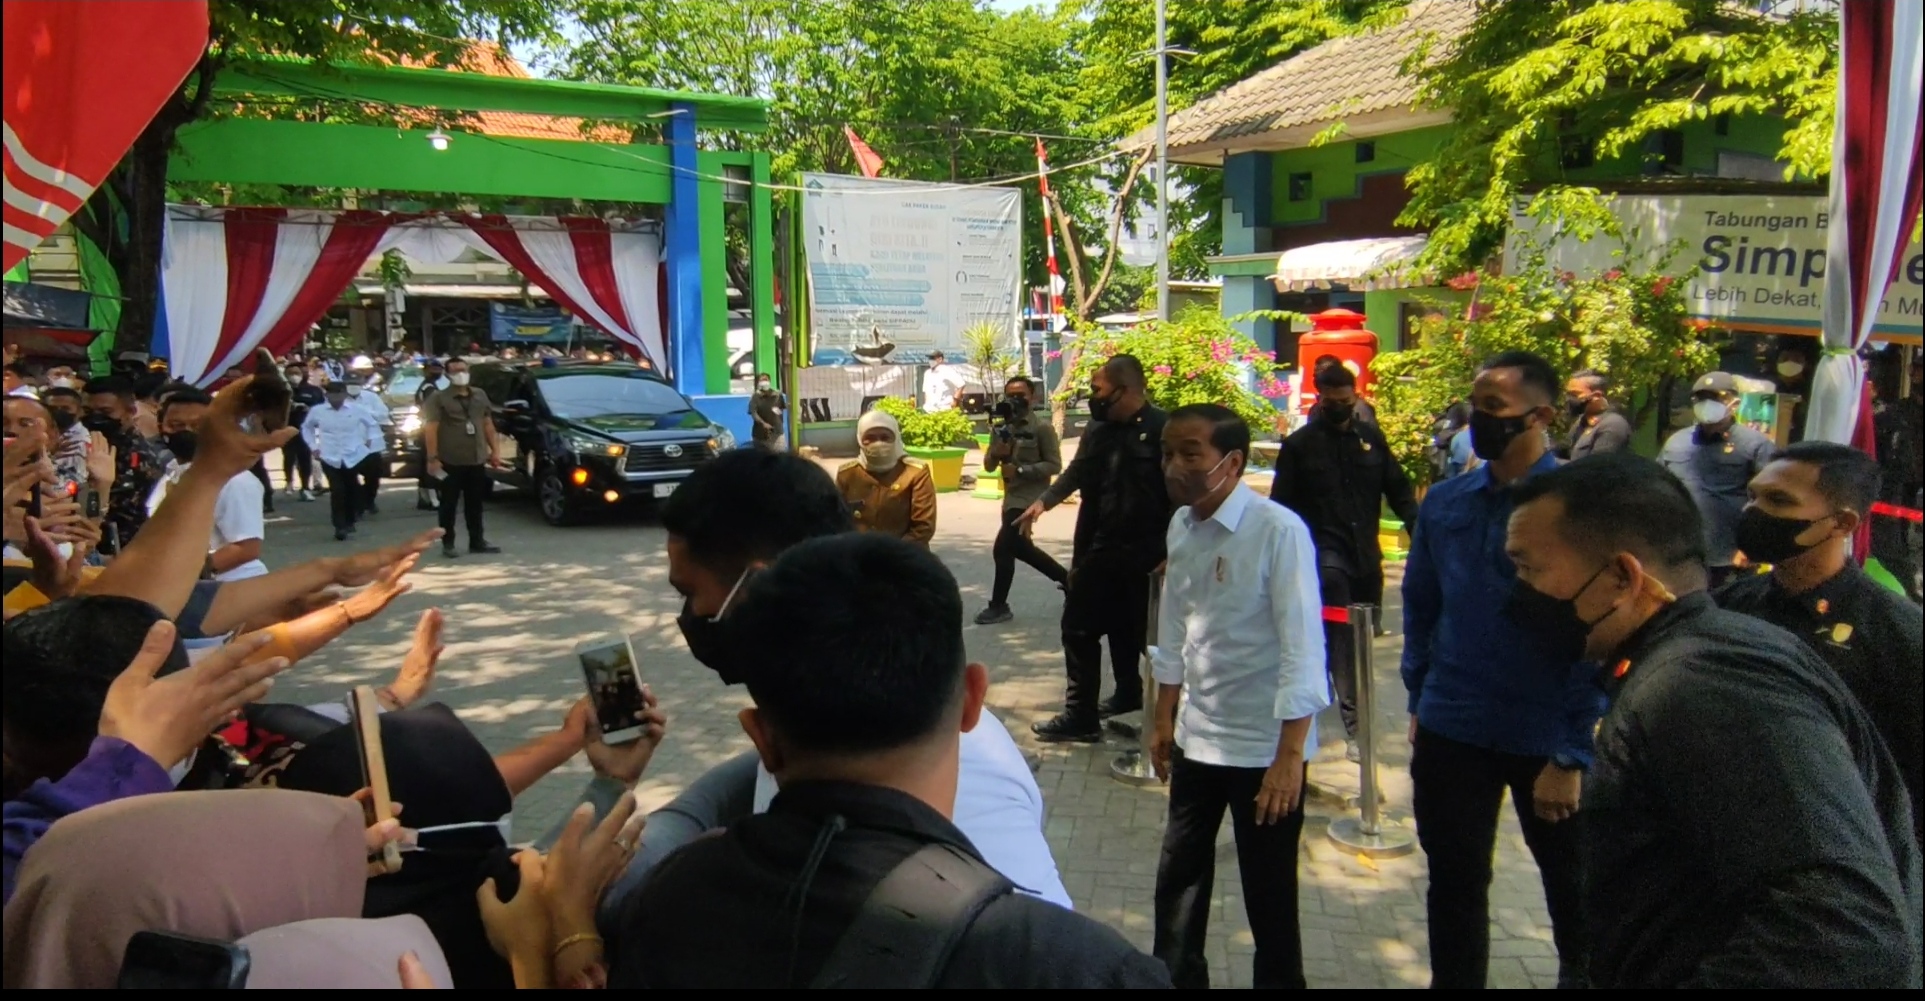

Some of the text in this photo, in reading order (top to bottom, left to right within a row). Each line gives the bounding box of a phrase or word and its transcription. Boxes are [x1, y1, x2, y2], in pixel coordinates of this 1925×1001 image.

[1704, 211, 1829, 231] Tabungan B
[1693, 285, 1821, 308] Lebih Dekat,
